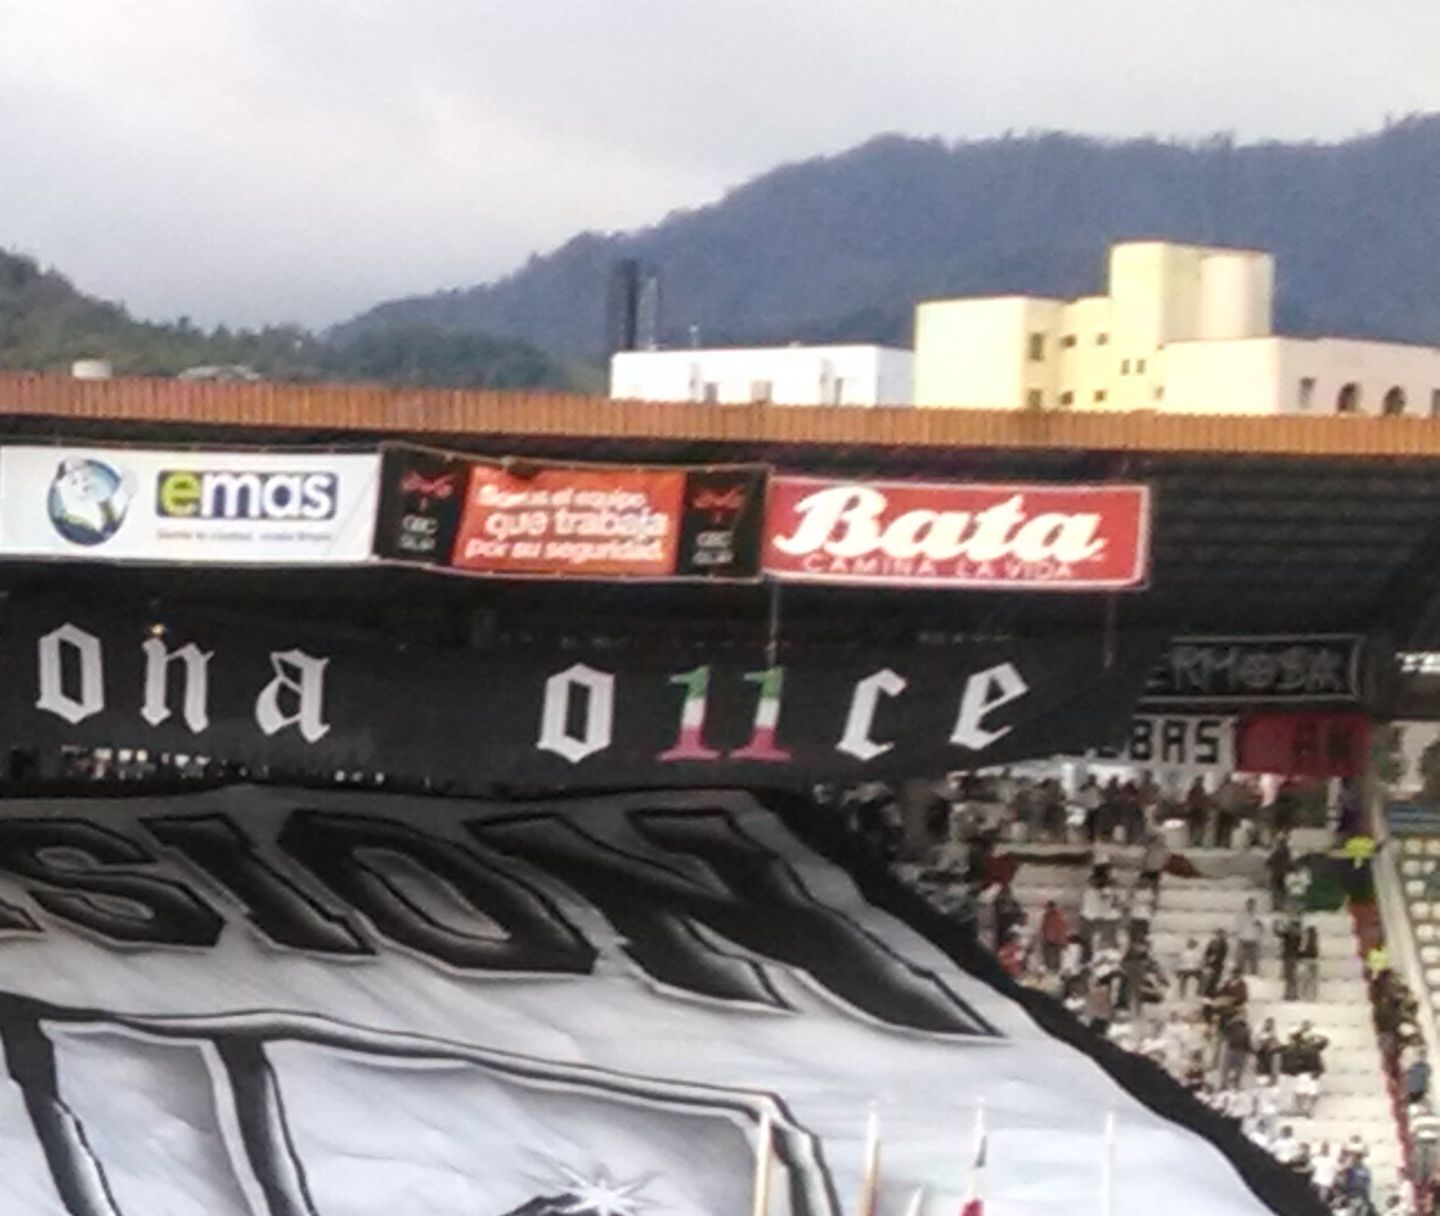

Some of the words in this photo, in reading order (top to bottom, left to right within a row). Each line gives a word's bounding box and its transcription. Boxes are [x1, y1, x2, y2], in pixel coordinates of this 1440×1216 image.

[160, 472, 333, 519] emas
[485, 511, 548, 541] que
[555, 506, 669, 540] trabaja
[773, 485, 1107, 562] Bata
[803, 554, 937, 577] CAMINA
[956, 557, 995, 578] LA
[1007, 558, 1072, 578] VIDA
